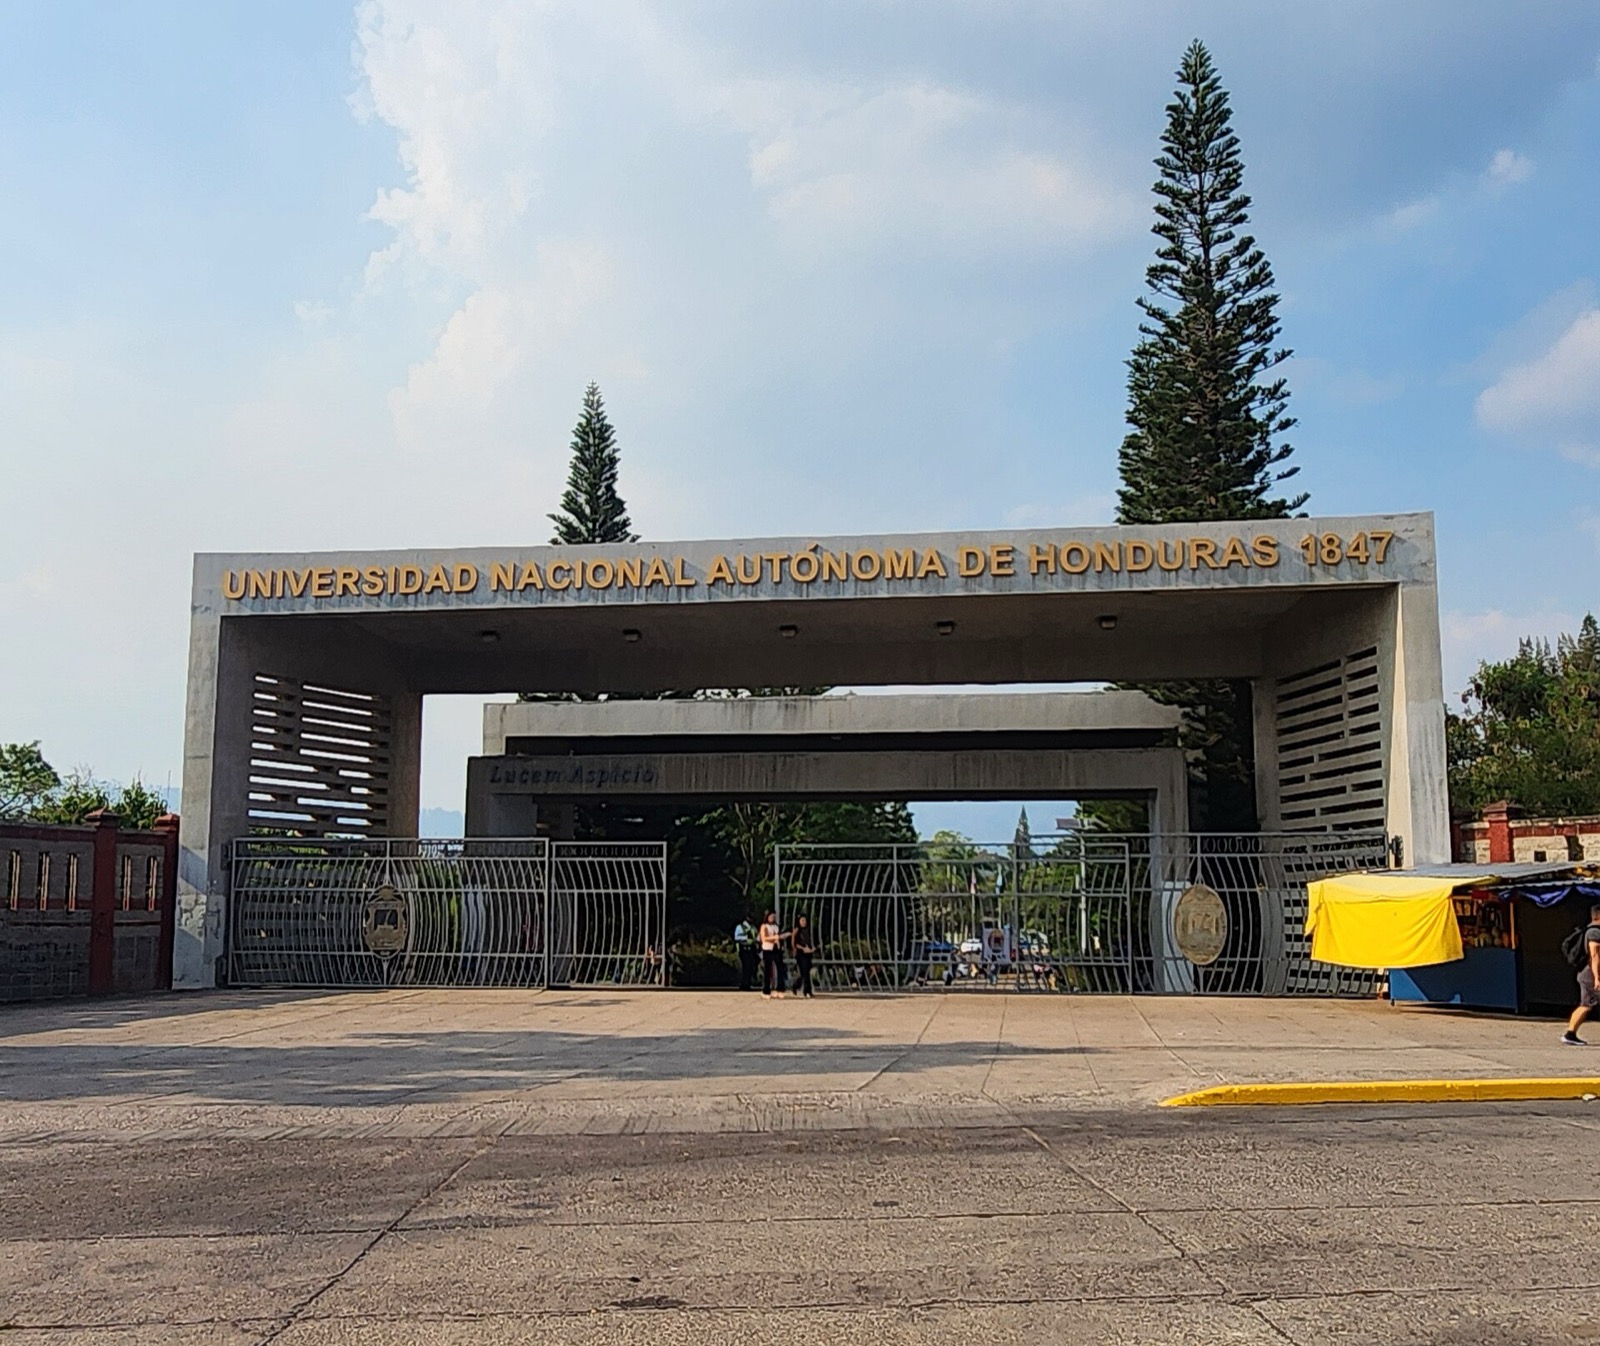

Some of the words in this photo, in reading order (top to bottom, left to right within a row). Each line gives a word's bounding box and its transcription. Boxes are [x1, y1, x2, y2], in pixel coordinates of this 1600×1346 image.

[222, 563, 478, 599] UNIVERSIDAD
[490, 556, 696, 592] NACIONAL
[706, 540, 948, 585] AUTÓNOMA
[957, 545, 1014, 578] DE
[1028, 535, 1280, 574] HONDURAS
[1301, 531, 1393, 566] 1847
[489, 765, 561, 784] Lucem
[567, 765, 654, 789] Aspicio
